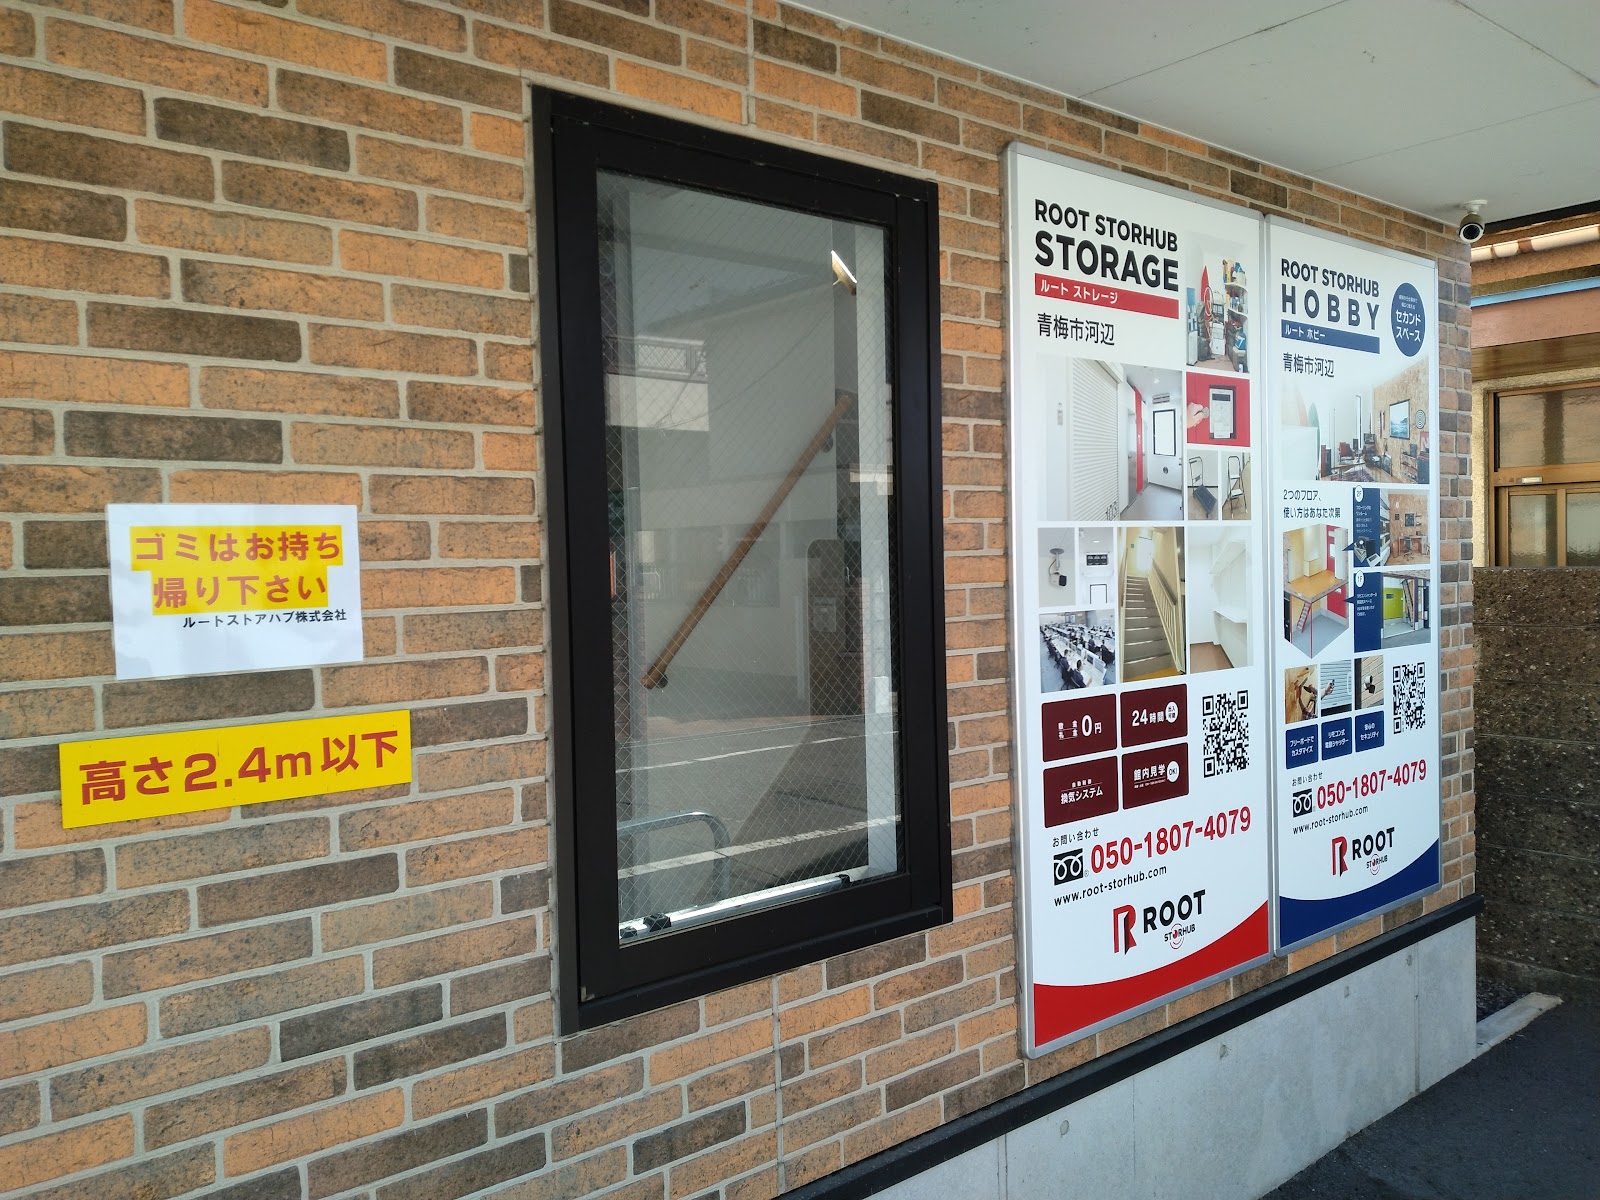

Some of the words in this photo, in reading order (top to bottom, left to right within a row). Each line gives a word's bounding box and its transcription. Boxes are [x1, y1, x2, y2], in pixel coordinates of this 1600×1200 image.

[1035, 199, 1090, 231] ROOT
[1095, 214, 1178, 252] STORHUB
[1035, 230, 1179, 292] STORAGE
[1281, 258, 1318, 283] ROOT
[1322, 269, 1379, 298] STORHUB
[1040, 279, 1068, 296] ルート
[1073, 286, 1118, 304] ストレージ
[1282, 284, 1380, 330] HOBBY
[1396, 309, 1421, 326] セカンド
[1037, 312, 1115, 346] 青梅市河辺
[1285, 324, 1304, 338] ルート
[1396, 326, 1420, 342] スペース
[1283, 352, 1334, 378] 青梅市河辺
[1283, 489, 1322, 502] 2つのフロア、
[1283, 506, 1341, 519] 使い方はあなた次第
[135, 531, 340, 562] ゴミはお持ち
[153, 574, 327, 609] 帰り下さい
[182, 609, 347, 629] ルートストアハブ株式会社
[1082, 715, 1102, 736] 0円
[1132, 709, 1164, 727] 24時間
[1290, 736, 1314, 748] フリーボードで
[1328, 729, 1345, 738] リモコン式
[1360, 732, 1379, 741] セキュリティ
[1292, 746, 1313, 757] カスタマイズ
[79, 729, 399, 806] 高さ2.4m以下
[1134, 764, 1166, 781] 館内見学
[1292, 772, 1323, 787] お問い合わせ
[1317, 759, 1427, 810] 050-1807-4079
[1061, 786, 1103, 804] 換気システム
[1293, 805, 1369, 835] www.root-storhub.com
[1052, 828, 1100, 847] お問い合わせ
[1091, 806, 1251, 873] 050-1807-4079
[1352, 827, 1395, 861] ROOT
[1054, 865, 1167, 907] www.root-storhub.com
[1143, 889, 1206, 934] ROOT
